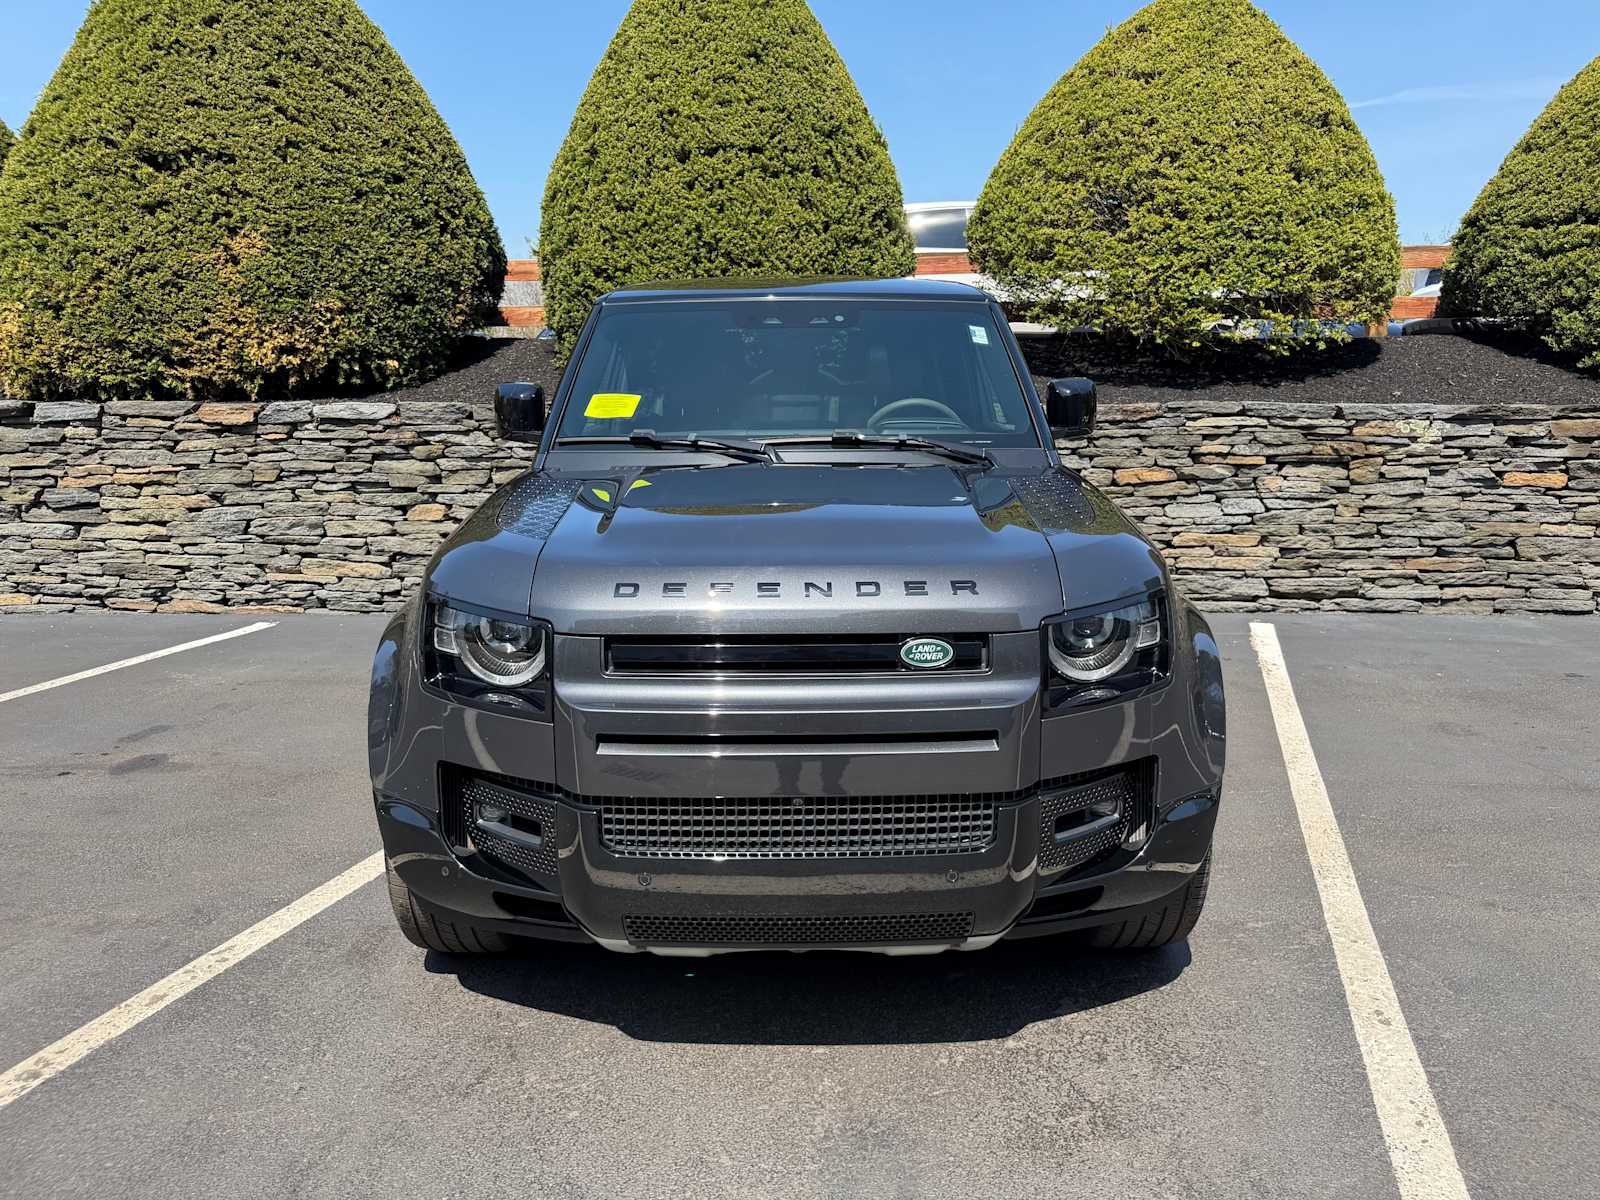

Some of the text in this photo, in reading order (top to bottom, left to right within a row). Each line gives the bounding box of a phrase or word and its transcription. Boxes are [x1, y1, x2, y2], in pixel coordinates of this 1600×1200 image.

[613, 580, 980, 598] DEFENDER
[912, 645, 936, 653] LAND
[914, 652, 944, 660] ROVER
